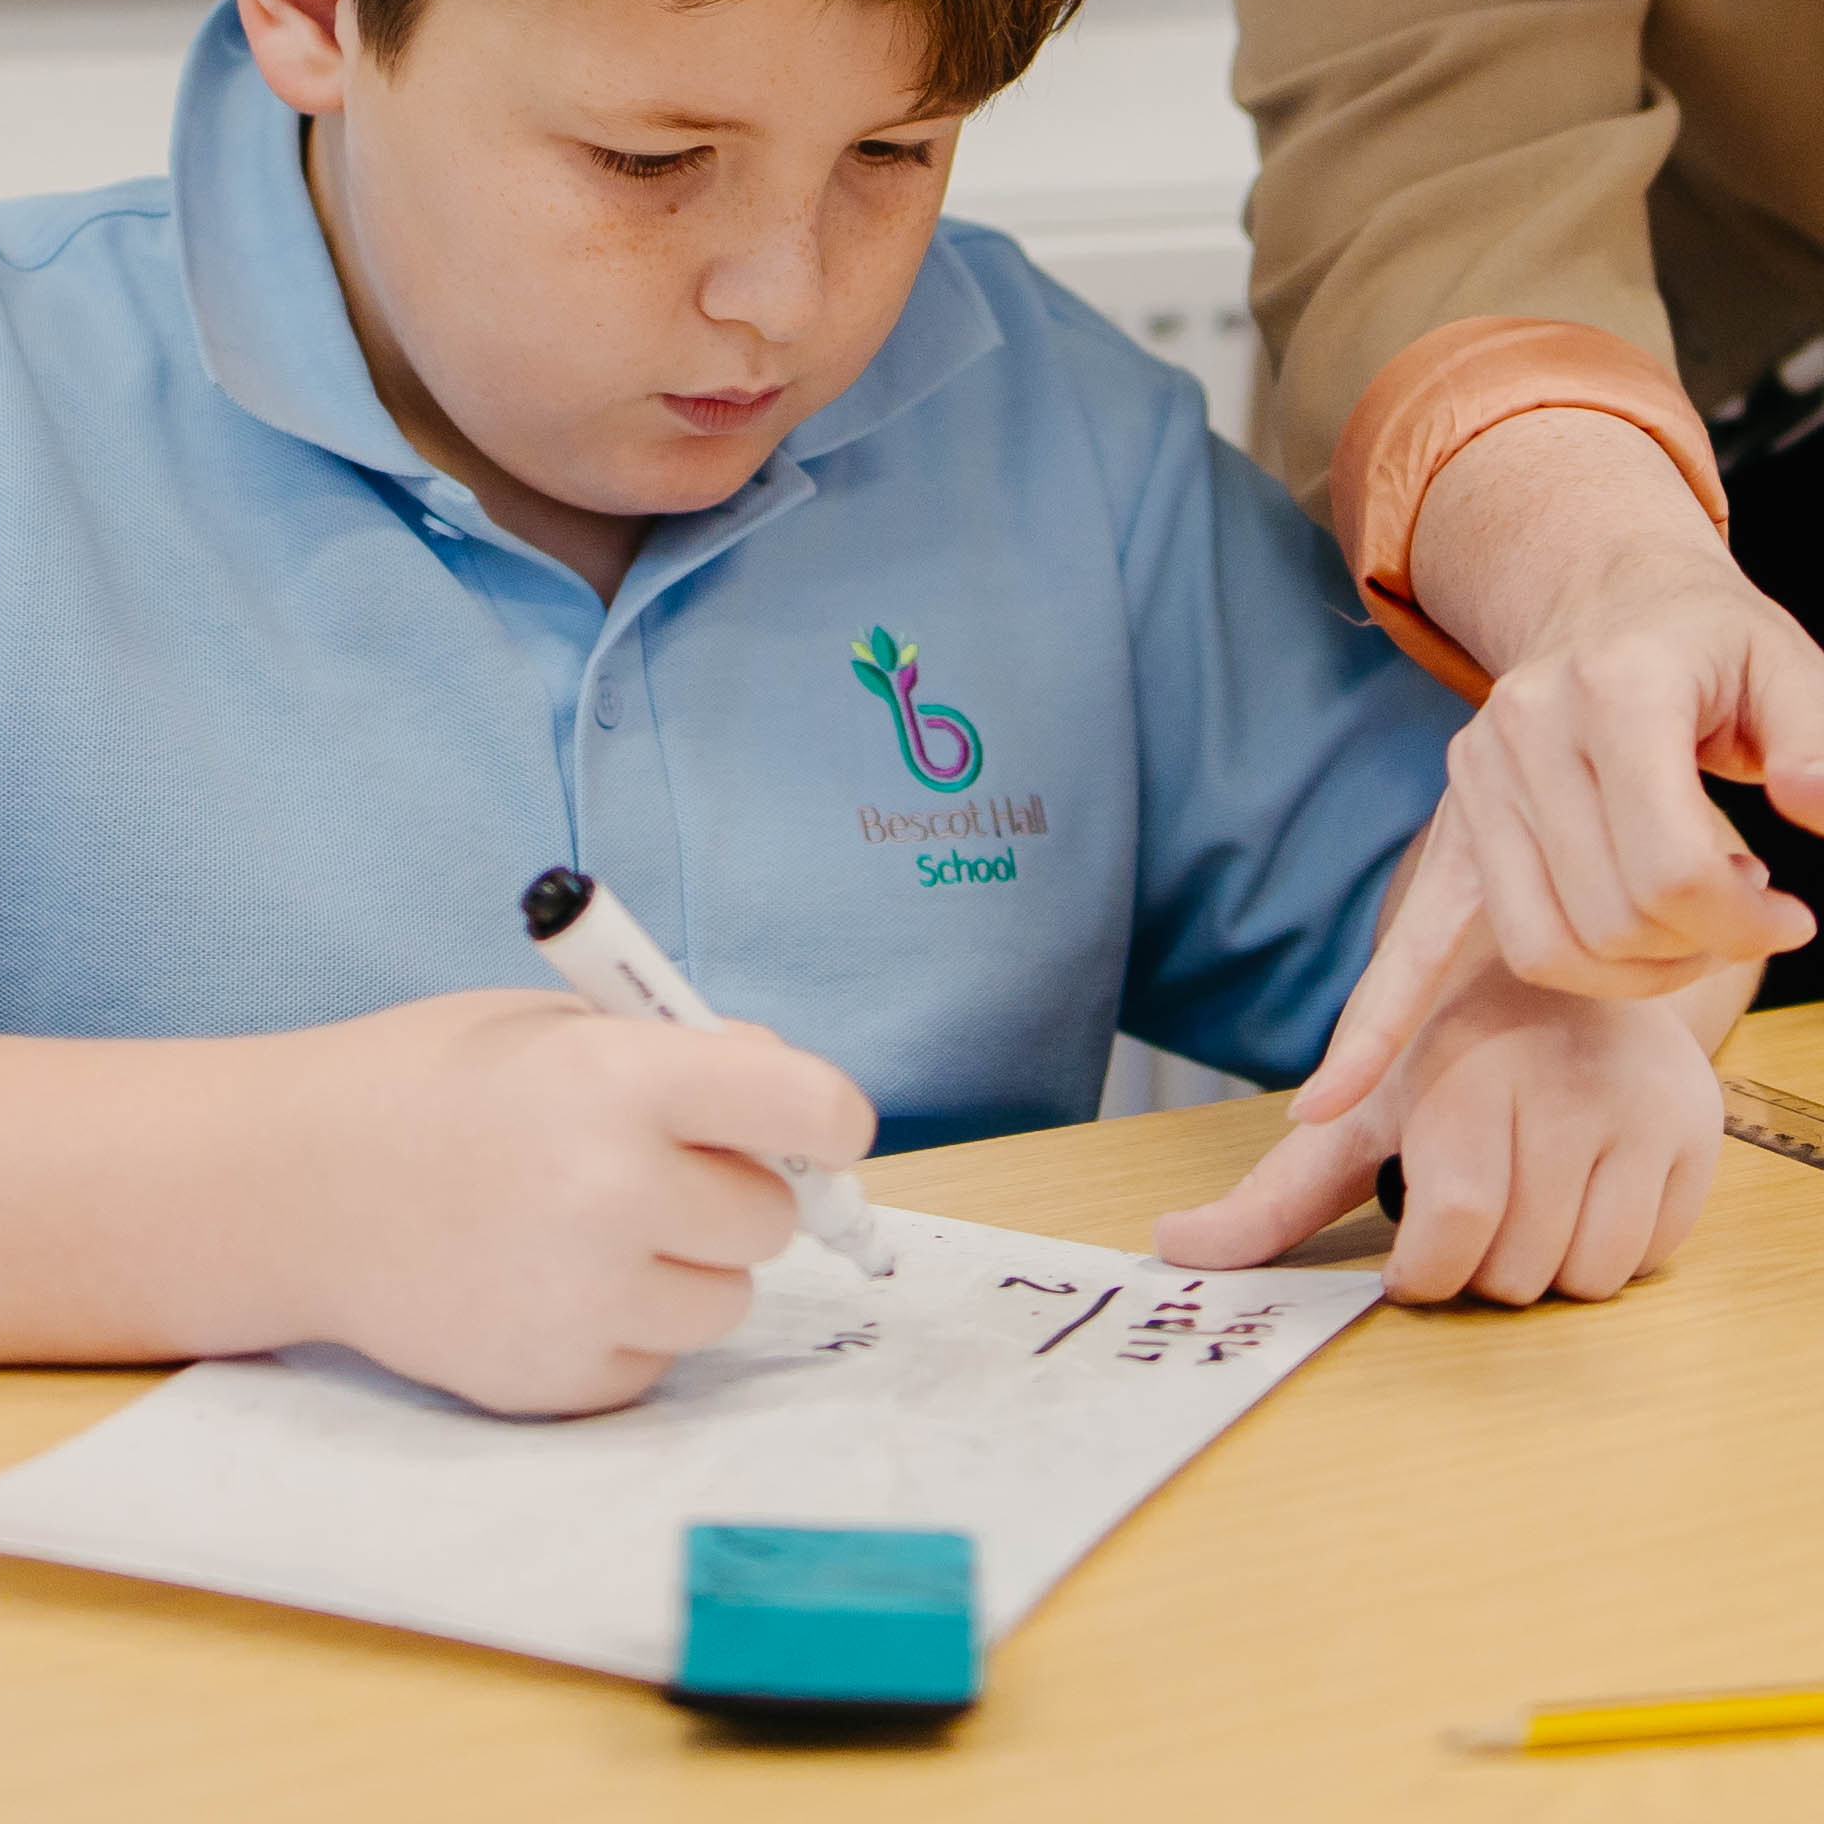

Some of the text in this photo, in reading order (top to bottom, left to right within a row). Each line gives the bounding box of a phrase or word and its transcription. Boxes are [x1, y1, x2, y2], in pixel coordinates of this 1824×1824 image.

[856, 793, 1050, 845] Bescot Hall
[915, 845, 1018, 888] School
